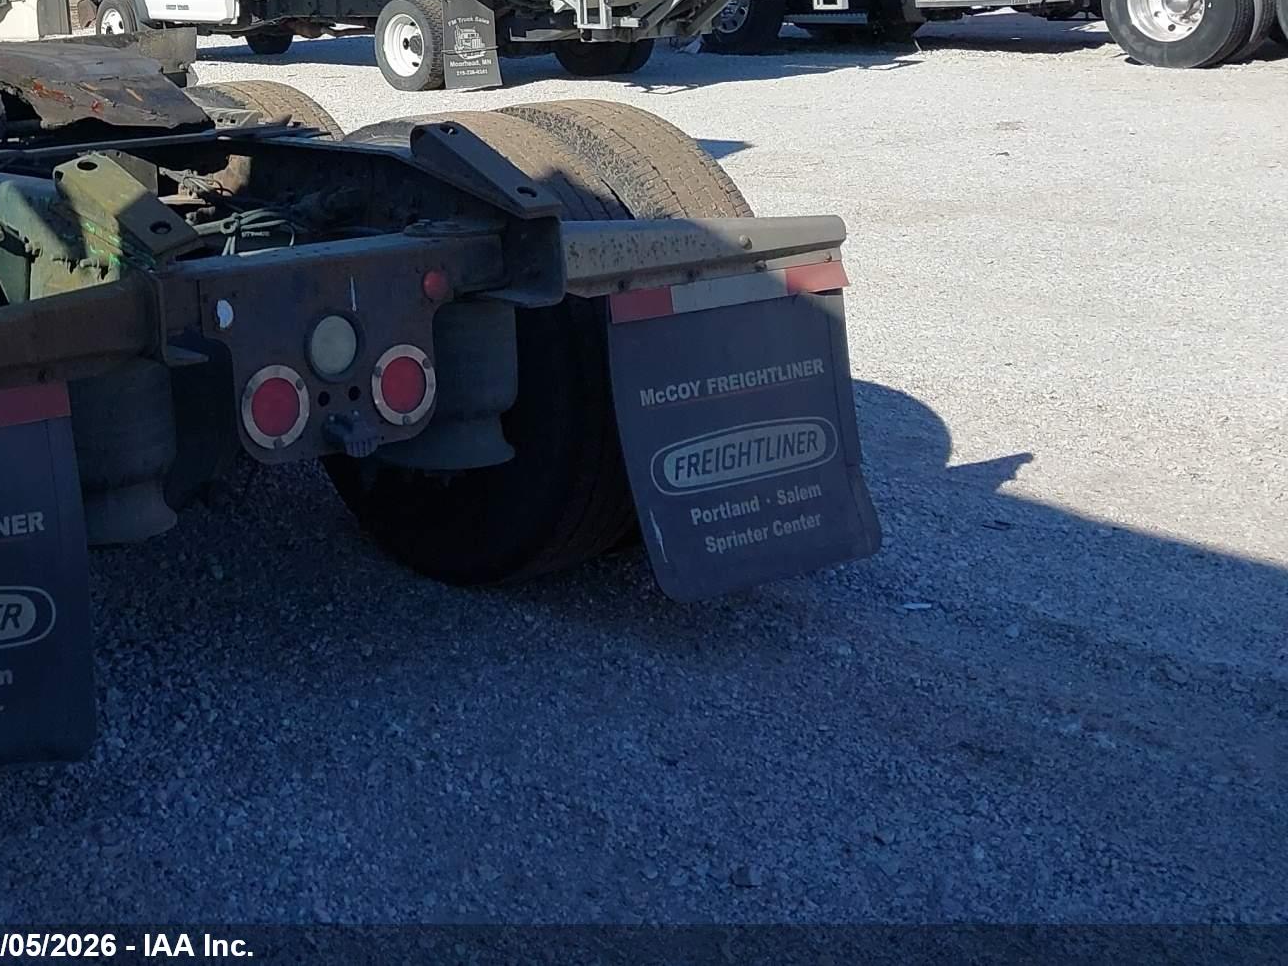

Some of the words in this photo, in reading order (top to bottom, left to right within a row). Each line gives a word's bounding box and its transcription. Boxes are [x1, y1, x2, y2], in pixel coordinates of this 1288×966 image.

[640, 380, 701, 407] McCOY
[707, 358, 825, 395] FREIGHTLINER
[674, 430, 820, 481] FREIGHTLINER
[691, 496, 760, 525] Portland
[777, 483, 822, 506] Salem
[705, 524, 768, 555] Sprinter
[772, 512, 822, 536] Center
